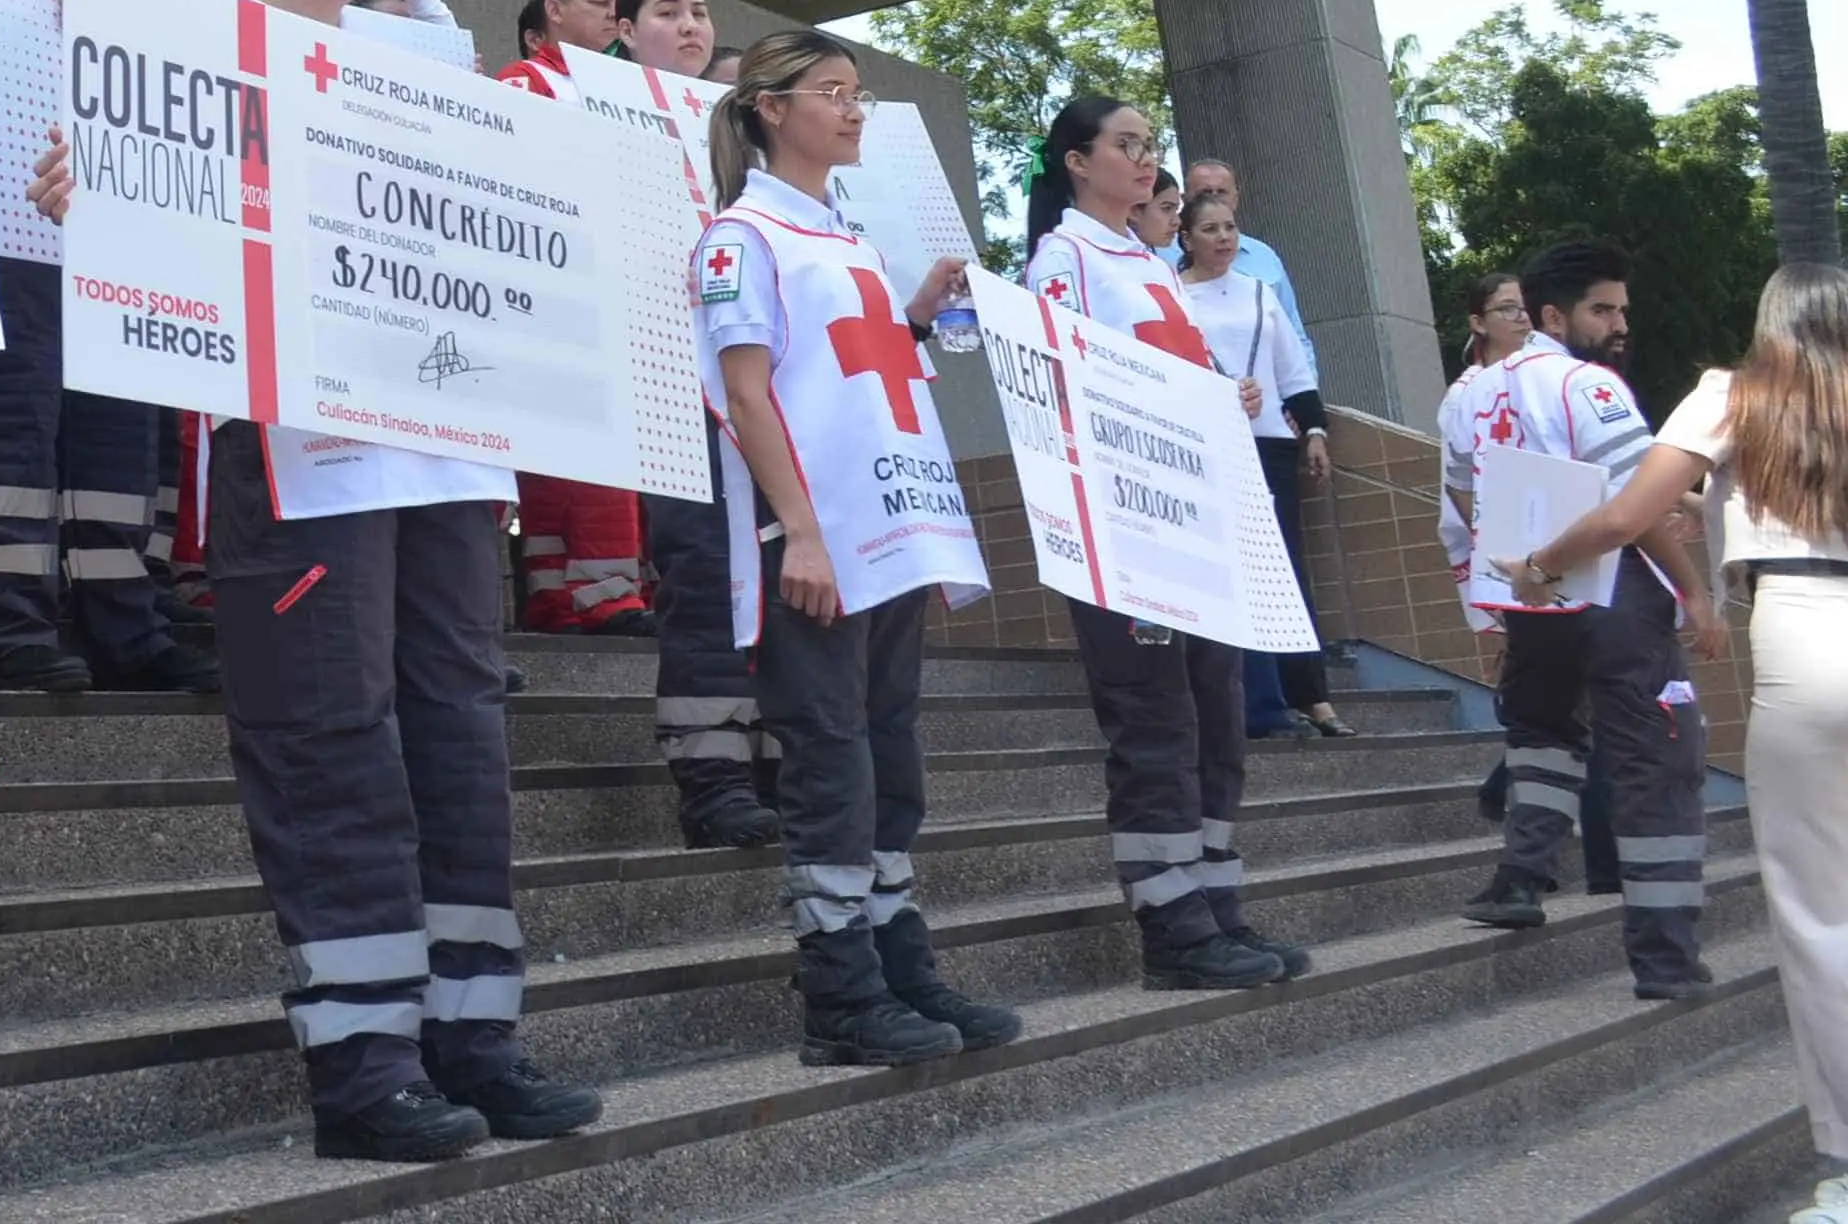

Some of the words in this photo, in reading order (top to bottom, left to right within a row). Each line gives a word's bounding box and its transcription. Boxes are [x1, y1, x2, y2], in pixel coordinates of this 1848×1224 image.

[72, 36, 268, 166] COLECTA
[342, 67, 384, 95] CRUZ
[389, 83, 429, 109] ROJA
[433, 95, 515, 135] MEXICANA
[73, 121, 235, 225] NACIONAL
[241, 185, 270, 209] 2024
[306, 127, 375, 159] DONATIVO
[378, 148, 443, 178] SOLIDARIO
[446, 167, 455, 182] A
[458, 170, 497, 194] FAVOR
[500, 183, 514, 199] DE
[516, 188, 546, 207] CRUZ
[550, 198, 580, 218] ROJA
[308, 214, 356, 240] NOMBRE
[359, 227, 378, 244] DEL
[380, 232, 435, 257] DONADOR
[73, 275, 143, 308] TODOS
[148, 292, 219, 324] SOMOS
[311, 295, 371, 319] CANTIDAD
[374, 305, 430, 336] (NÚMERO)
[123, 306, 235, 364] HÉROES
[315, 376, 350, 394] FIRMA
[316, 401, 378, 426] Culiacán
[381, 413, 431, 438] Sinaloa,
[435, 424, 478, 445] México
[481, 435, 510, 451] 2024
[1091, 411, 1133, 453] GRUPO
